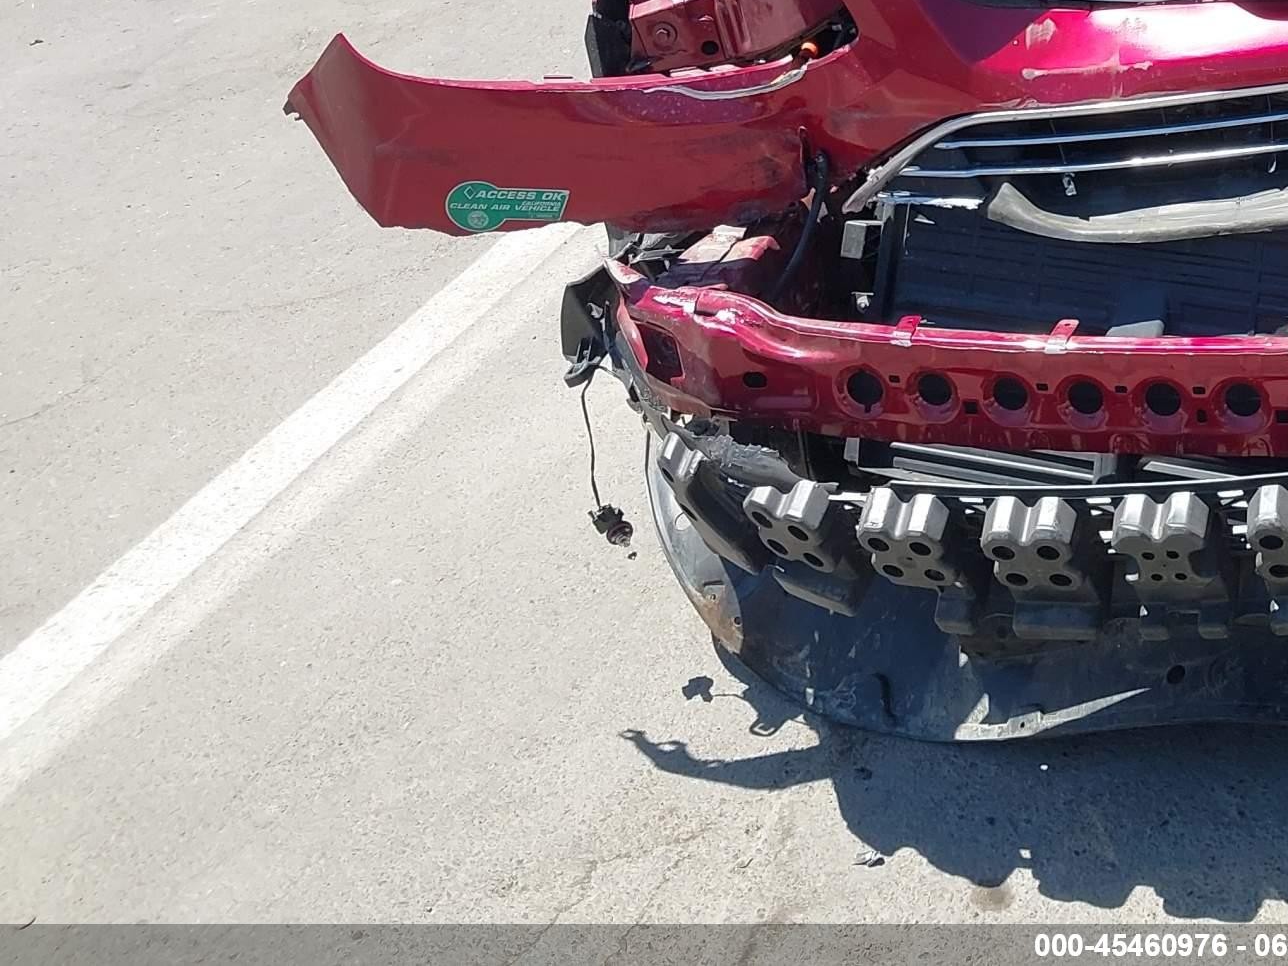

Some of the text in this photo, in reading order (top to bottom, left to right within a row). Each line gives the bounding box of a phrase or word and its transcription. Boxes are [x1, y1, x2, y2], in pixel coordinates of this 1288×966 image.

[475, 190, 564, 201] ACCESS OK
[450, 202, 488, 210] CLEAN
[490, 203, 510, 211] AIR
